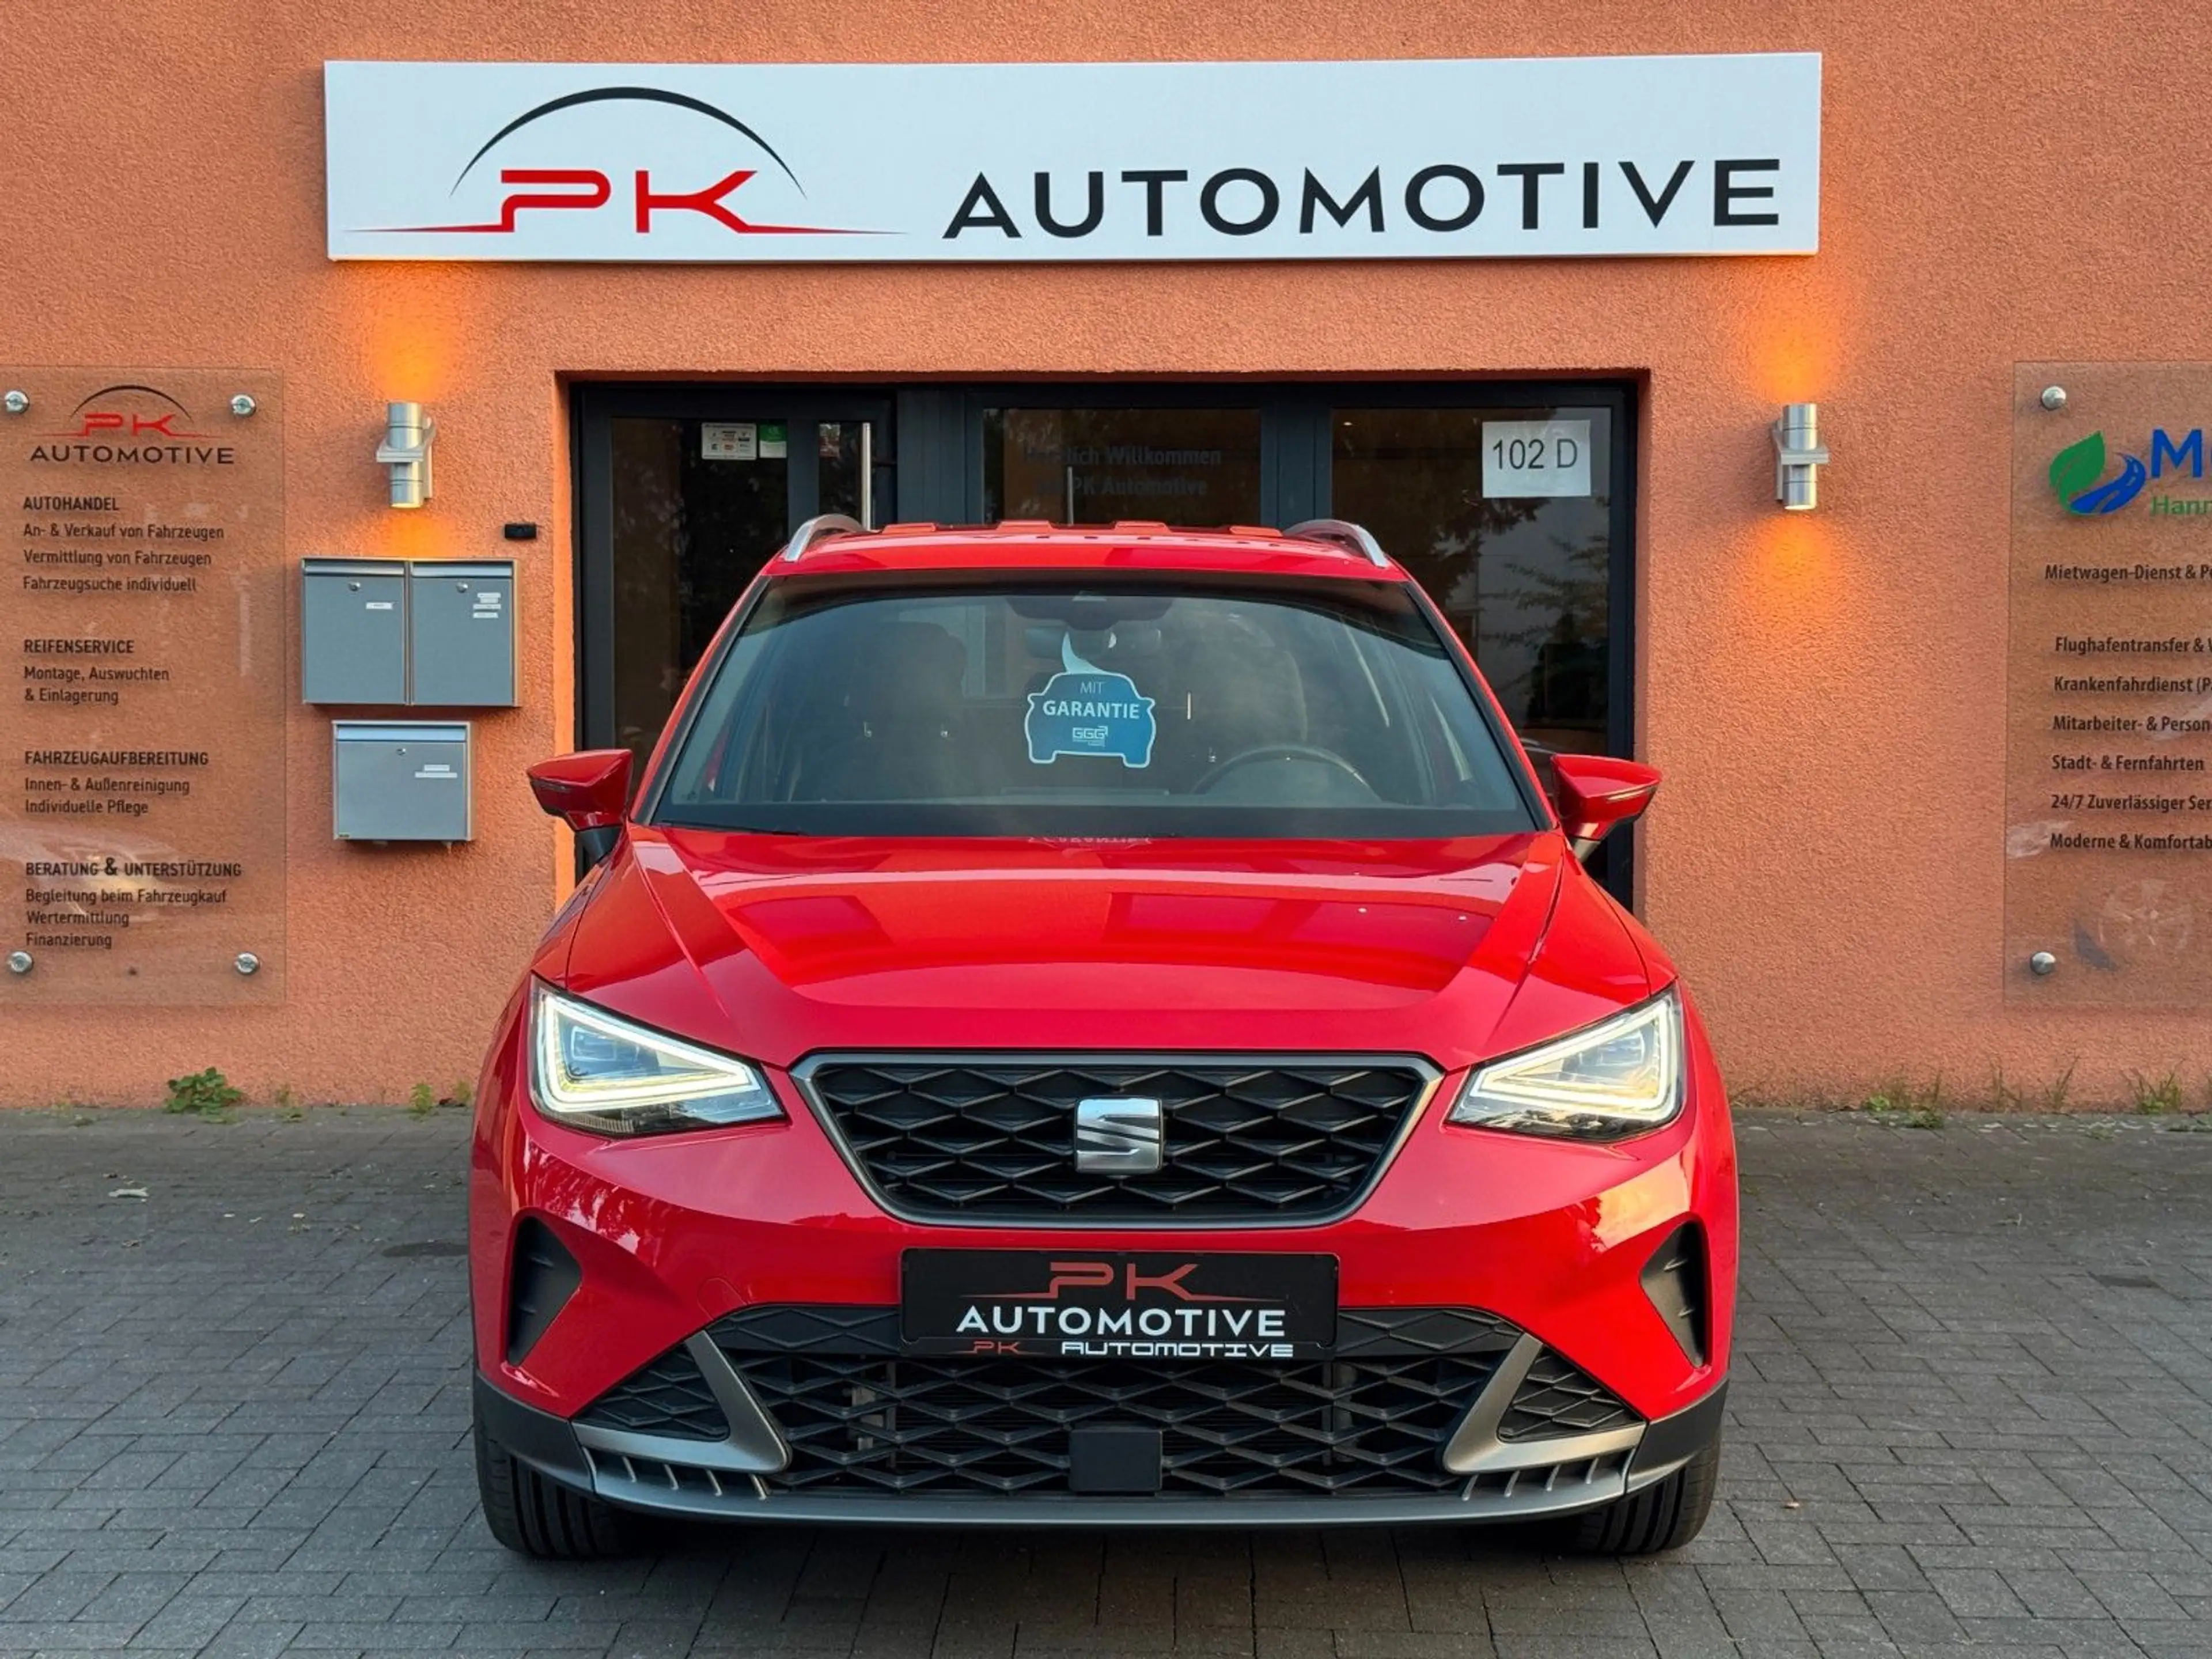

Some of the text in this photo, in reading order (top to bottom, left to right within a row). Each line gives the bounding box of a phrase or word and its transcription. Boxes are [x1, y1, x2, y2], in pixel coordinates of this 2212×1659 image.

[501, 158, 1781, 240] PK AUTOMOTIVE
[85, 413, 175, 438] PK
[29, 446, 234, 464] AUTOMOTIVE
[1105, 445, 1222, 465] Willkommen
[1493, 438, 1578, 470] 102 D
[2151, 428, 2212, 478] M
[1101, 476, 1208, 496] Automotive
[23, 497, 120, 511] AUTOHANDEL
[23, 522, 225, 542] An- & Verkauf von Fahrzeugen
[23, 549, 211, 568] Vermittlung von Fahrzeugen
[2045, 563, 2181, 583] Mietwagen-Dienst
[2186, 564, 2196, 579] &
[23, 576, 197, 594] Fahrzeugsuche individuell
[24, 639, 135, 654] REIFENSERVICE
[2055, 637, 2191, 656] Flughafentransfer
[2193, 637, 2205, 653] &
[24, 665, 170, 683] Montage, Auswuchten
[1080, 681, 1105, 695] MIT
[2054, 676, 2193, 692] Krankenfahrdienst
[24, 687, 119, 706] & Einlagerung
[1043, 699, 1140, 719] GARANTIE
[2053, 715, 2142, 732] Mitarbeiter-
[2146, 715, 2157, 732] &
[25, 751, 209, 766] FAHRZEUGAUFBEREITUNG
[2052, 755, 2205, 771] Stadt- & Fernfahrten
[25, 777, 190, 795] Innen- & Außenreinigung
[25, 799, 149, 817] Individuelle Pflege
[2051, 794, 2083, 809] 24/7
[2087, 794, 2186, 813] Zuverlässiger
[2050, 833, 2116, 849] Moderne
[2119, 834, 2130, 850] &
[26, 857, 242, 877] BERATUNG & UNTERSTÜTZUNG
[26, 888, 227, 907] Begleitung beim Fahrzeugkauf
[26, 911, 130, 927] Wertermittlung
[26, 932, 112, 949] Finanzierung
[1050, 1262, 1200, 1301] PK
[956, 1305, 1286, 1337] AUTOMOTIVE
[973, 1340, 1294, 1358] PK AUTOMOTIVE
